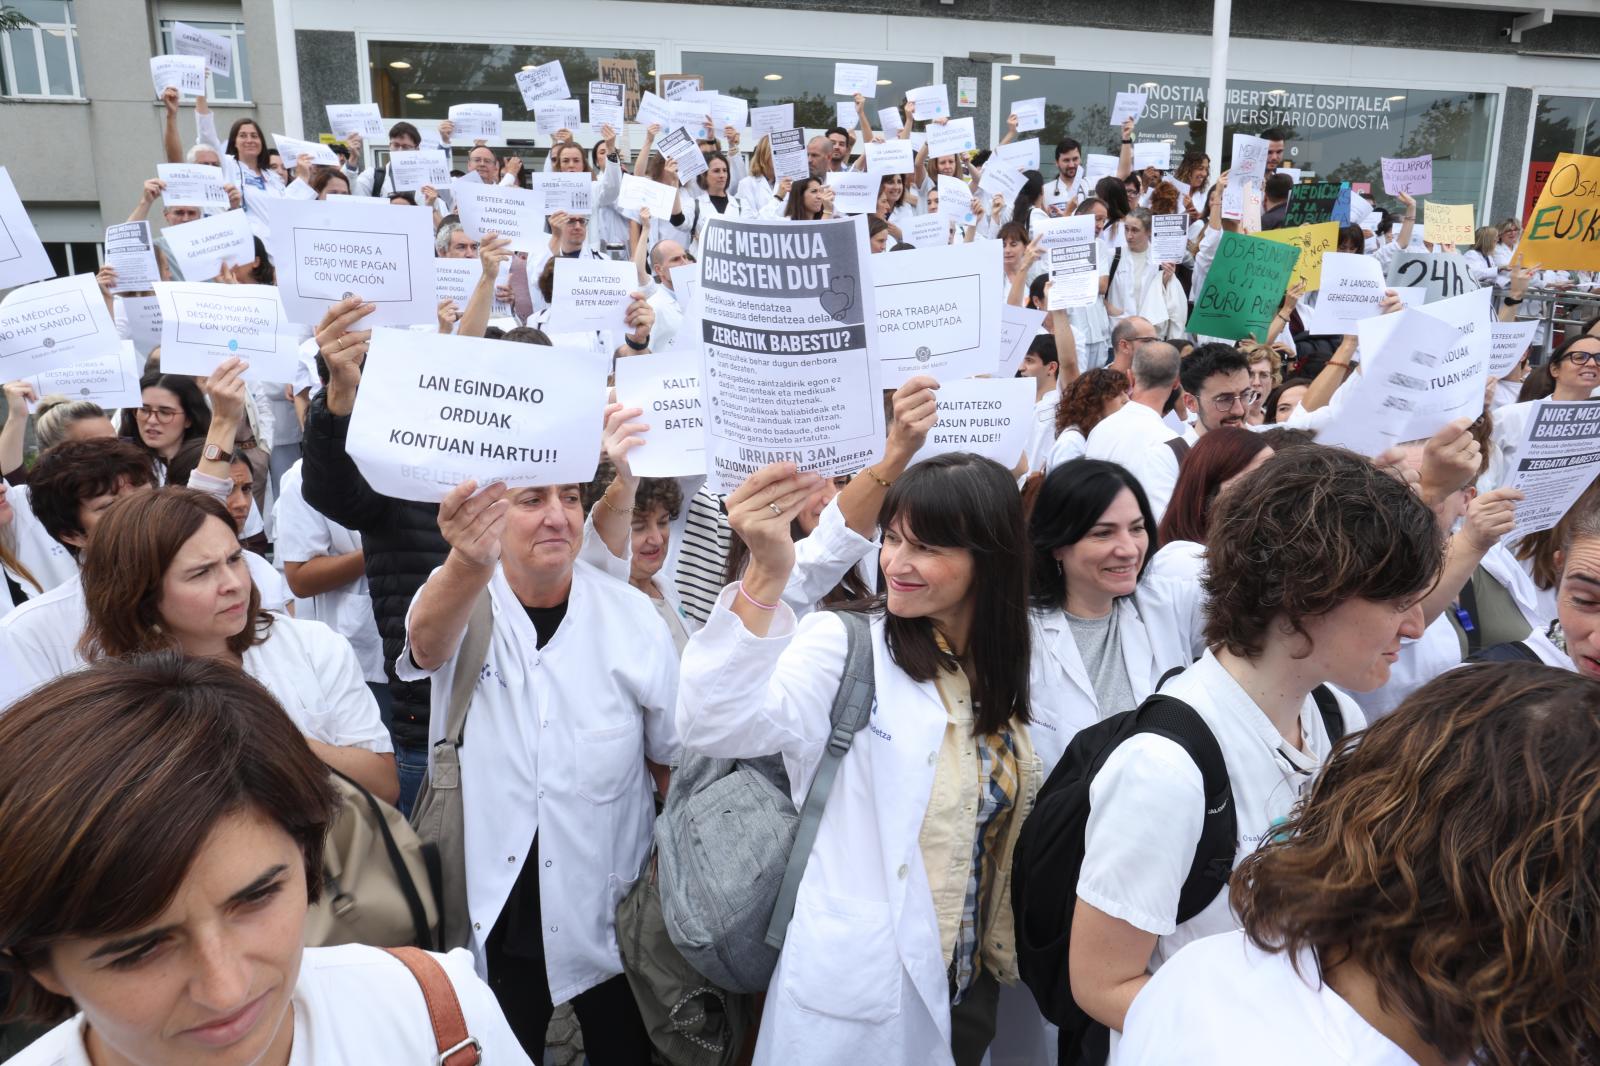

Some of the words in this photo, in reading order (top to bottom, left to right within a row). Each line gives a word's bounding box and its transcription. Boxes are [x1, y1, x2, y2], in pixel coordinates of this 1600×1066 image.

[1127, 83, 1204, 103] DONOSTIA
[1317, 95, 1392, 112] OSPITALEA
[1139, 104, 1202, 122] OSPITAL
[1317, 113, 1391, 131] DONOSTIA
[476, 195, 503, 204] BESTEEK
[503, 198, 525, 207] ADINA
[484, 206, 516, 216] LANORDU
[480, 216, 497, 225] NAHI
[1528, 205, 1600, 242] EUSK
[313, 242, 337, 253] HAGO
[339, 244, 372, 255] HORAS
[375, 246, 383, 255] A
[706, 226, 733, 255] NIRE
[735, 230, 828, 260] MEDIKUA
[304, 256, 337, 269] DESTAJO
[339, 259, 359, 269] YME
[361, 260, 397, 271] PAGAN
[314, 271, 332, 281] CON
[334, 273, 385, 285] VOCACIÓN
[578, 275, 621, 284] KALITATEZKO
[704, 256, 783, 290] BABESTEN
[786, 263, 831, 290] DUT
[571, 288, 599, 297] OSASUN
[600, 289, 627, 297] PUBLIKO
[1199, 284, 1245, 312] BURU
[1327, 292, 1369, 303] GEHIEGIZKOA
[575, 299, 597, 307] BATEN
[737, 299, 792, 313] defendatzea
[905, 302, 958, 318] TRABAJADA
[2, 318, 20, 328] SIN
[186, 309, 223, 322] DESTAJO
[244, 316, 270, 327] PAGAN
[718, 309, 747, 321] osasuna
[748, 312, 805, 324] defendatzea
[16, 324, 38, 337] HAY
[39, 313, 86, 331] SANIDAD
[199, 322, 218, 331] CON
[902, 317, 962, 332] COMPUTADA
[711, 325, 768, 352] ZERGATIK
[770, 329, 851, 352] BABESTU?
[772, 359, 799, 369] dugun
[800, 357, 838, 368] denbora
[418, 373, 450, 392] LAN
[453, 378, 545, 405] EGINDAKO
[807, 378, 829, 388] egon
[831, 376, 842, 384] ez
[778, 389, 792, 398] eta
[793, 385, 837, 396] medikuak
[652, 398, 702, 412] OSASUN
[831, 403, 846, 412] eta
[936, 400, 1002, 411] KALITATEZKO
[439, 405, 512, 430] ORDUAK
[813, 413, 842, 423] ditzan.
[1540, 407, 1576, 422] NIRE
[664, 417, 704, 431] BATEN
[753, 427, 773, 435] ondo
[814, 424, 841, 433] denok
[969, 417, 1011, 428] PUBLIKO
[1534, 423, 1600, 438] BABESTEN
[933, 433, 967, 444] BATEN
[970, 433, 1002, 444] ALDE!!
[388, 429, 475, 456] KONTUAN
[479, 442, 558, 464] HARTU!!
[738, 446, 804, 466] URRIAREN
[807, 445, 837, 462] 3AN
[1527, 458, 1570, 470] ZERGATIK
[1568, 453, 1600, 466] BABESTU
